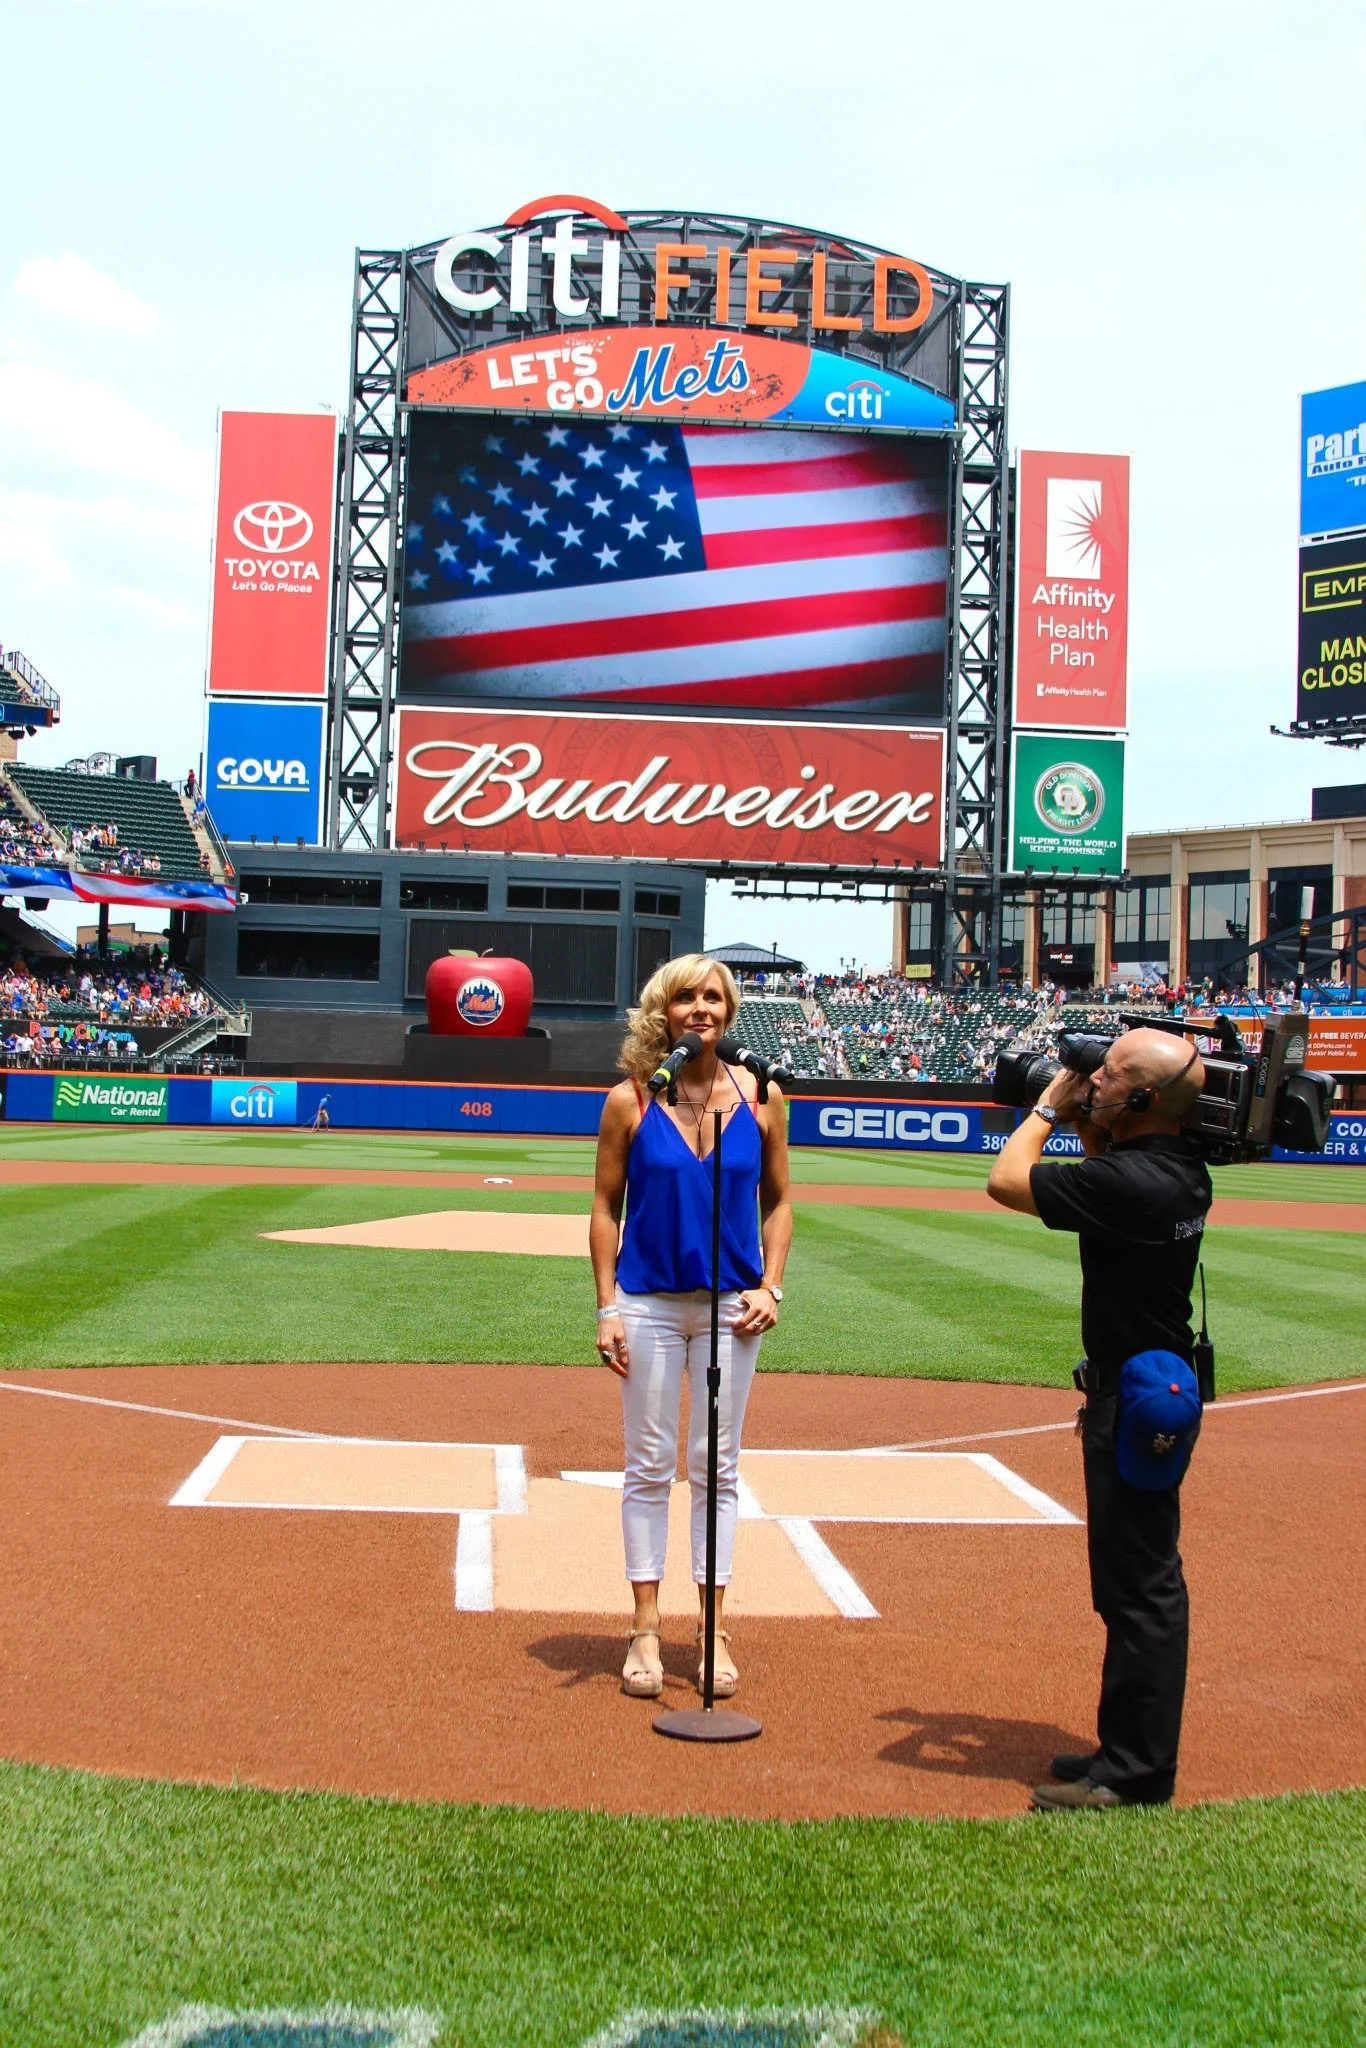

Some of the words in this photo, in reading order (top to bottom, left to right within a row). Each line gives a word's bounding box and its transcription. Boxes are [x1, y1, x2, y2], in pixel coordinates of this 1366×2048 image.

[434, 214, 620, 318] citi
[655, 242, 934, 333] FIELD
[486, 342, 599, 391] LET'S
[606, 338, 750, 413] Mets
[546, 376, 602, 412] GO
[825, 384, 882, 419] citi
[223, 558, 320, 580] TOYOTA
[232, 580, 257, 592] Let's
[259, 581, 275, 592] Go
[277, 582, 313, 594] Places
[1031, 583, 1116, 614] Affinity
[1037, 615, 1109, 641] Health
[1050, 643, 1095, 667] Plan
[1302, 661, 1366, 690] CLOS
[1045, 686, 1069, 697] Affinity
[1070, 687, 1092, 697] Health
[1093, 688, 1107, 697] Plan
[217, 757, 306, 785] GOYA
[405, 740, 934, 832] Budweiser
[1019, 836, 1060, 846] HELPING
[1063, 838, 1082, 847] THE
[1084, 839, 1117, 849] WORLD
[1030, 844, 1055, 853] KEEP
[1320, 1032, 1339, 1040] FREE
[110, 1107, 127, 1116] Car
[130, 1107, 160, 1117] Rental
[230, 1089, 274, 1118] citi
[460, 1102, 492, 1117] 408
[819, 1107, 969, 1143] GEICO
[1336, 1122, 1366, 1137] CO
[1043, 1138, 1084, 1152] KONI
